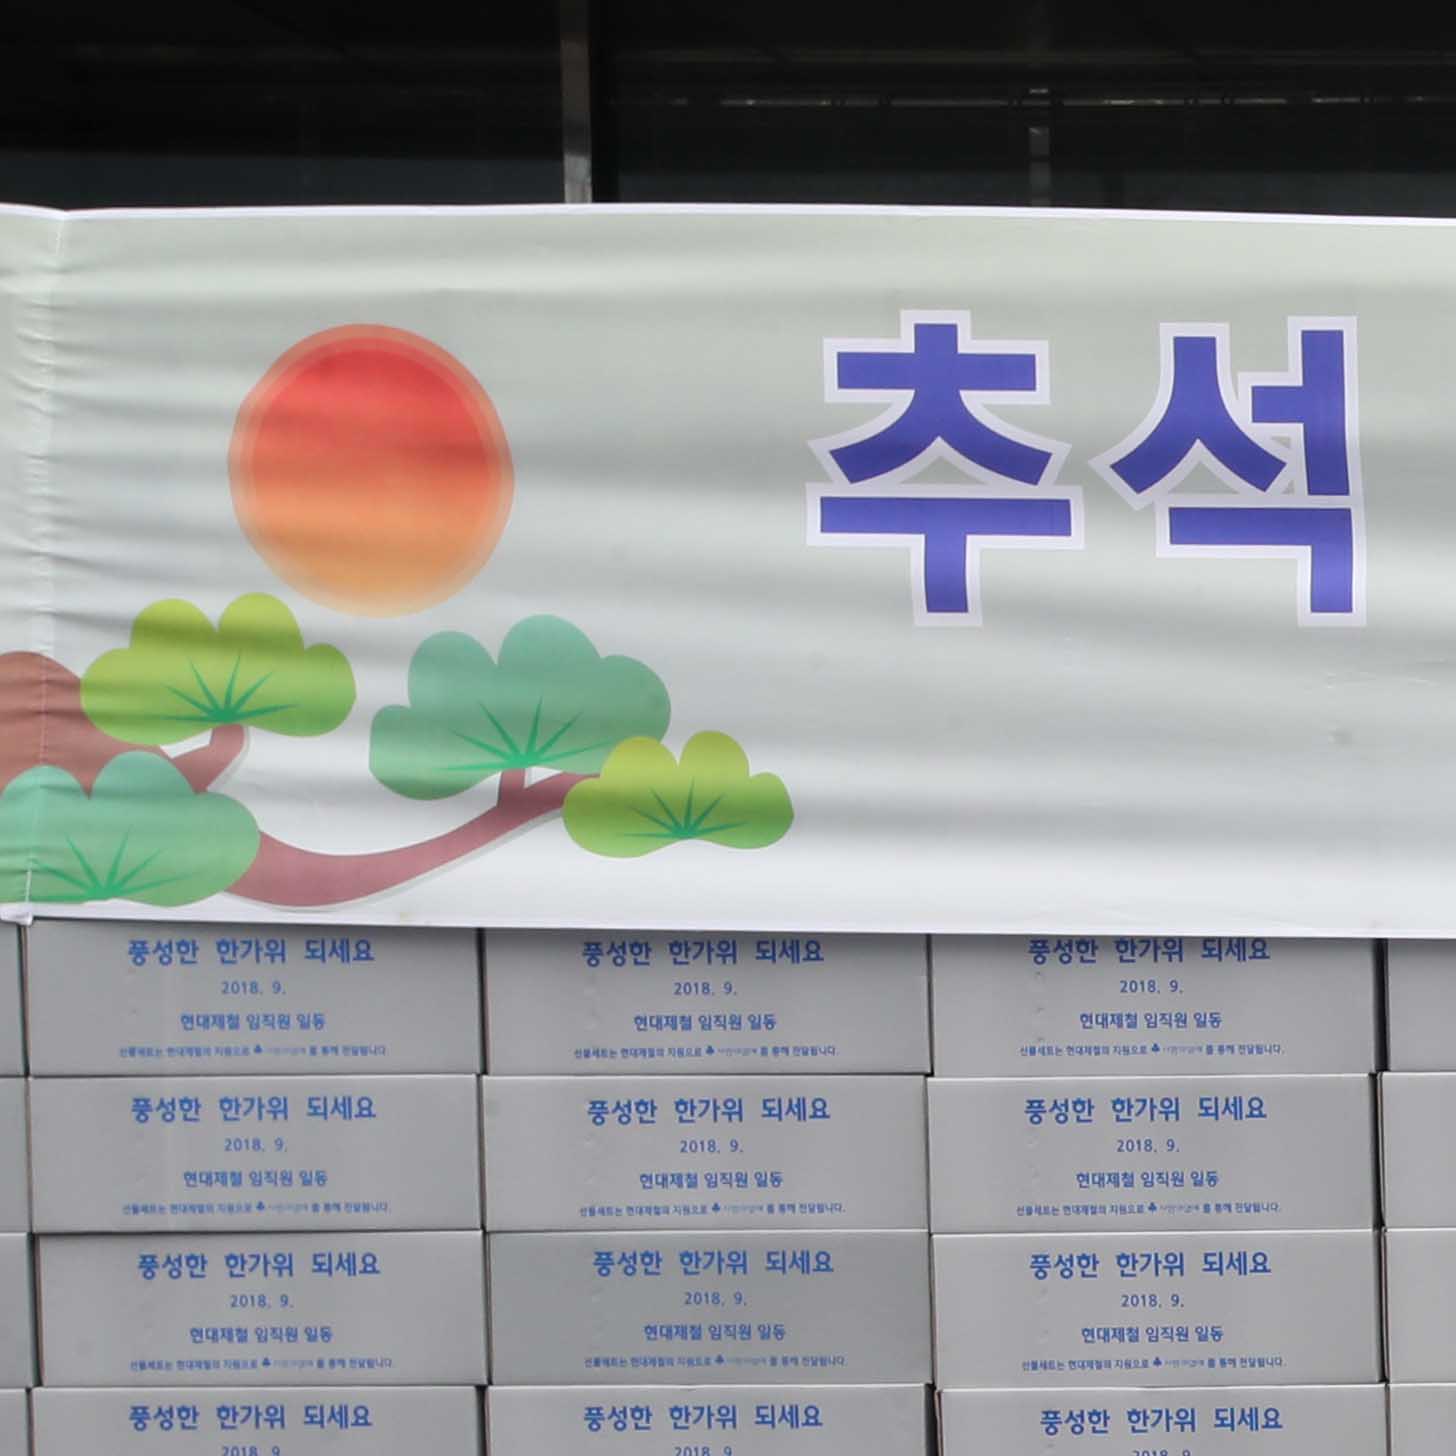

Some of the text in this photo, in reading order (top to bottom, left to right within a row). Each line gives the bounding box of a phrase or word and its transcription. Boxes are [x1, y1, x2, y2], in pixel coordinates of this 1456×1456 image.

[813, 316, 1360, 618] 추석
[127, 937, 375, 965] 풍성한 한가위 되세요
[180, 1012, 326, 1031] 현대제철 임직원 일동
[593, 1248, 834, 1276] 풍성한 한가위 되세요
[644, 1323, 786, 1341] 현대제철 임직원 일동
[1040, 1405, 1283, 1436] 풍성한 한가위 되세요
